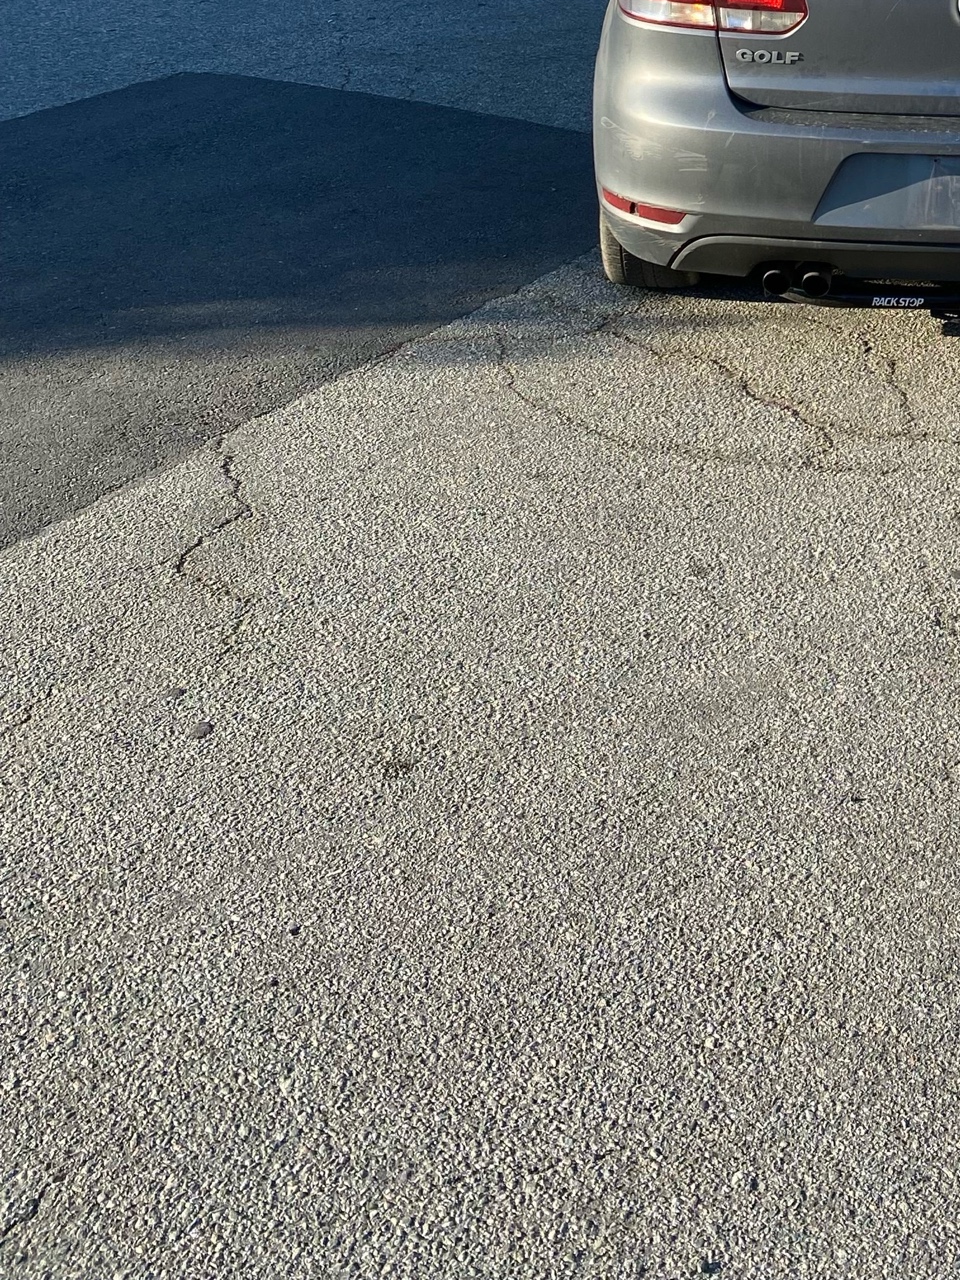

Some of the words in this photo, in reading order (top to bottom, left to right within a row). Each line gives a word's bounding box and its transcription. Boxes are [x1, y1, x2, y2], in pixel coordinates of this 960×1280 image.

[735, 48, 800, 64] GOLF
[871, 297, 898, 306] RACK
[898, 297, 925, 307] STOP
